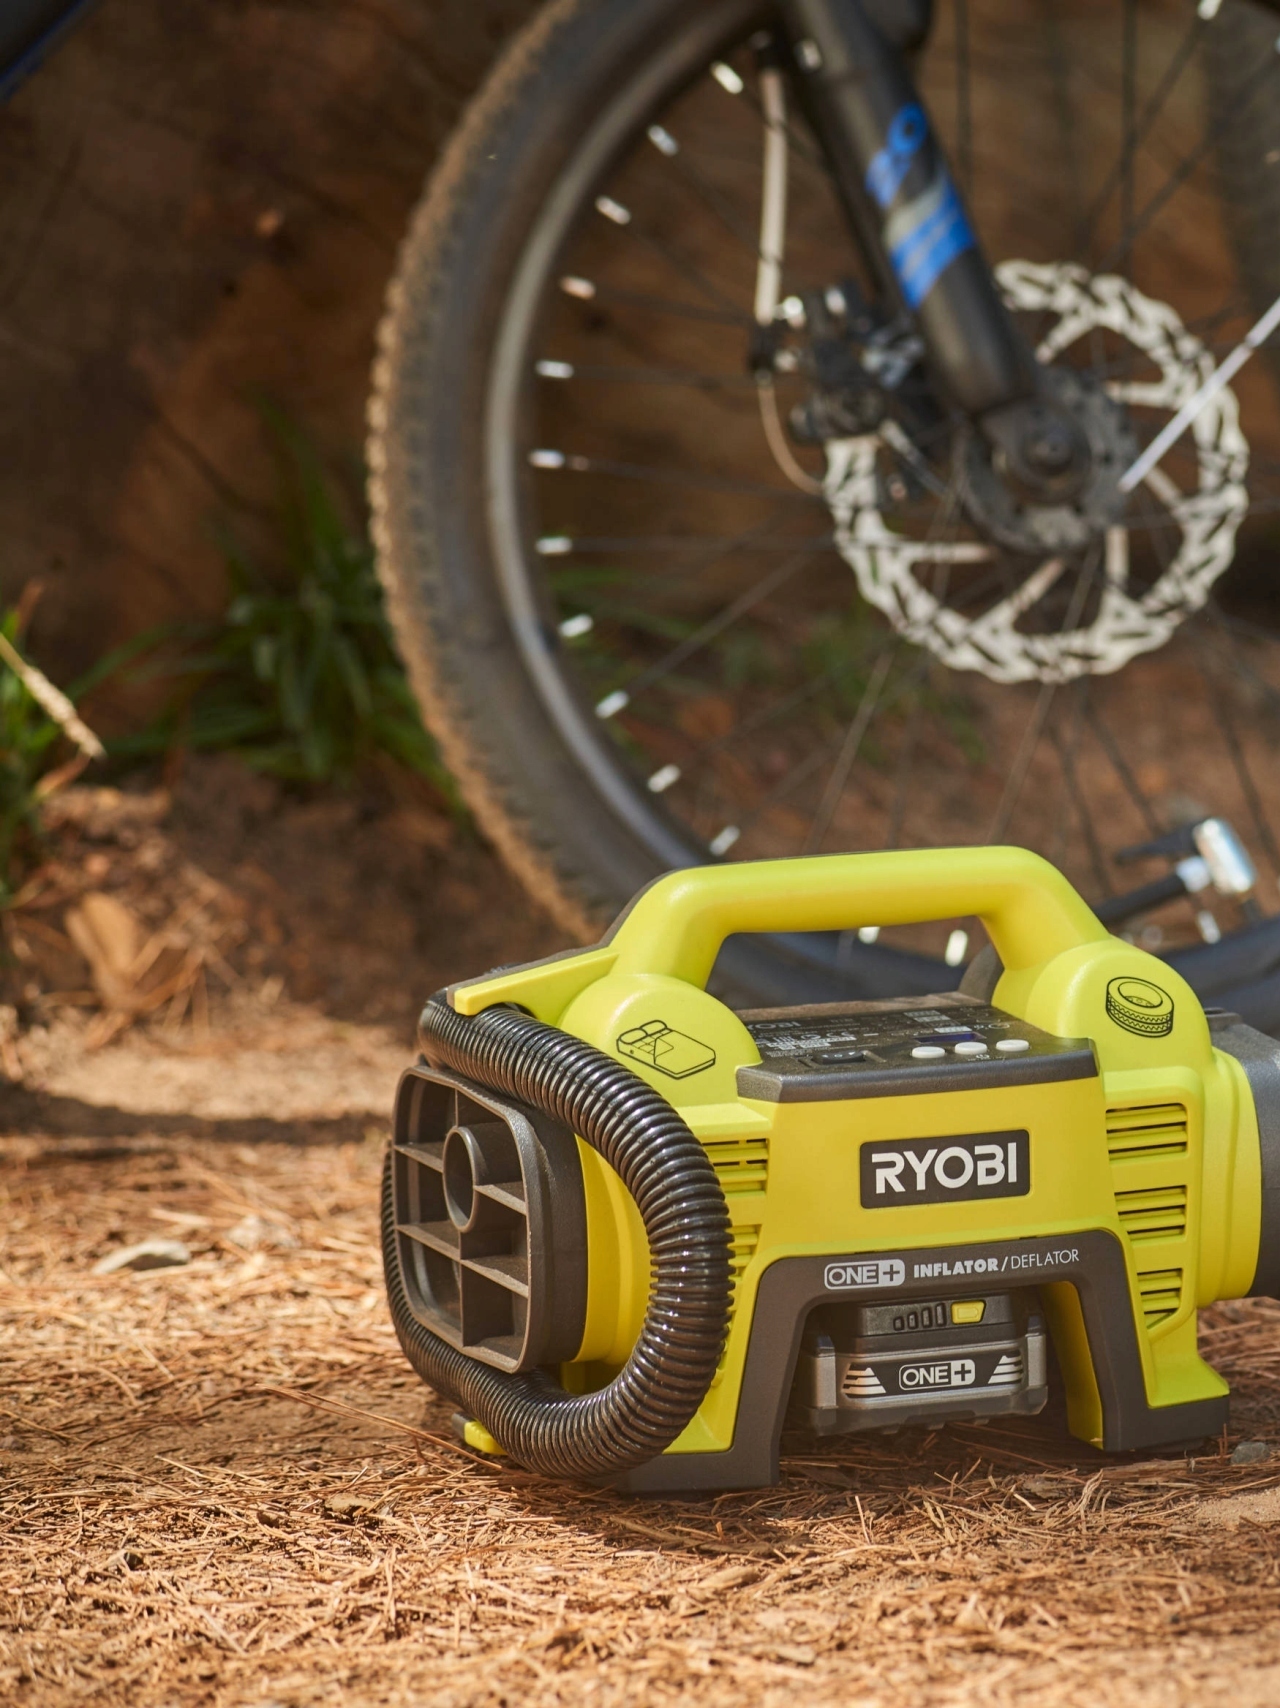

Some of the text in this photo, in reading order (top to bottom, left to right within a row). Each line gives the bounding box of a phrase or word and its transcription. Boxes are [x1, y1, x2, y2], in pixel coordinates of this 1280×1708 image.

[871, 1142, 1018, 1194] RYOBI
[826, 1262, 903, 1288] ONE+
[901, 1361, 973, 1388] ONE+
